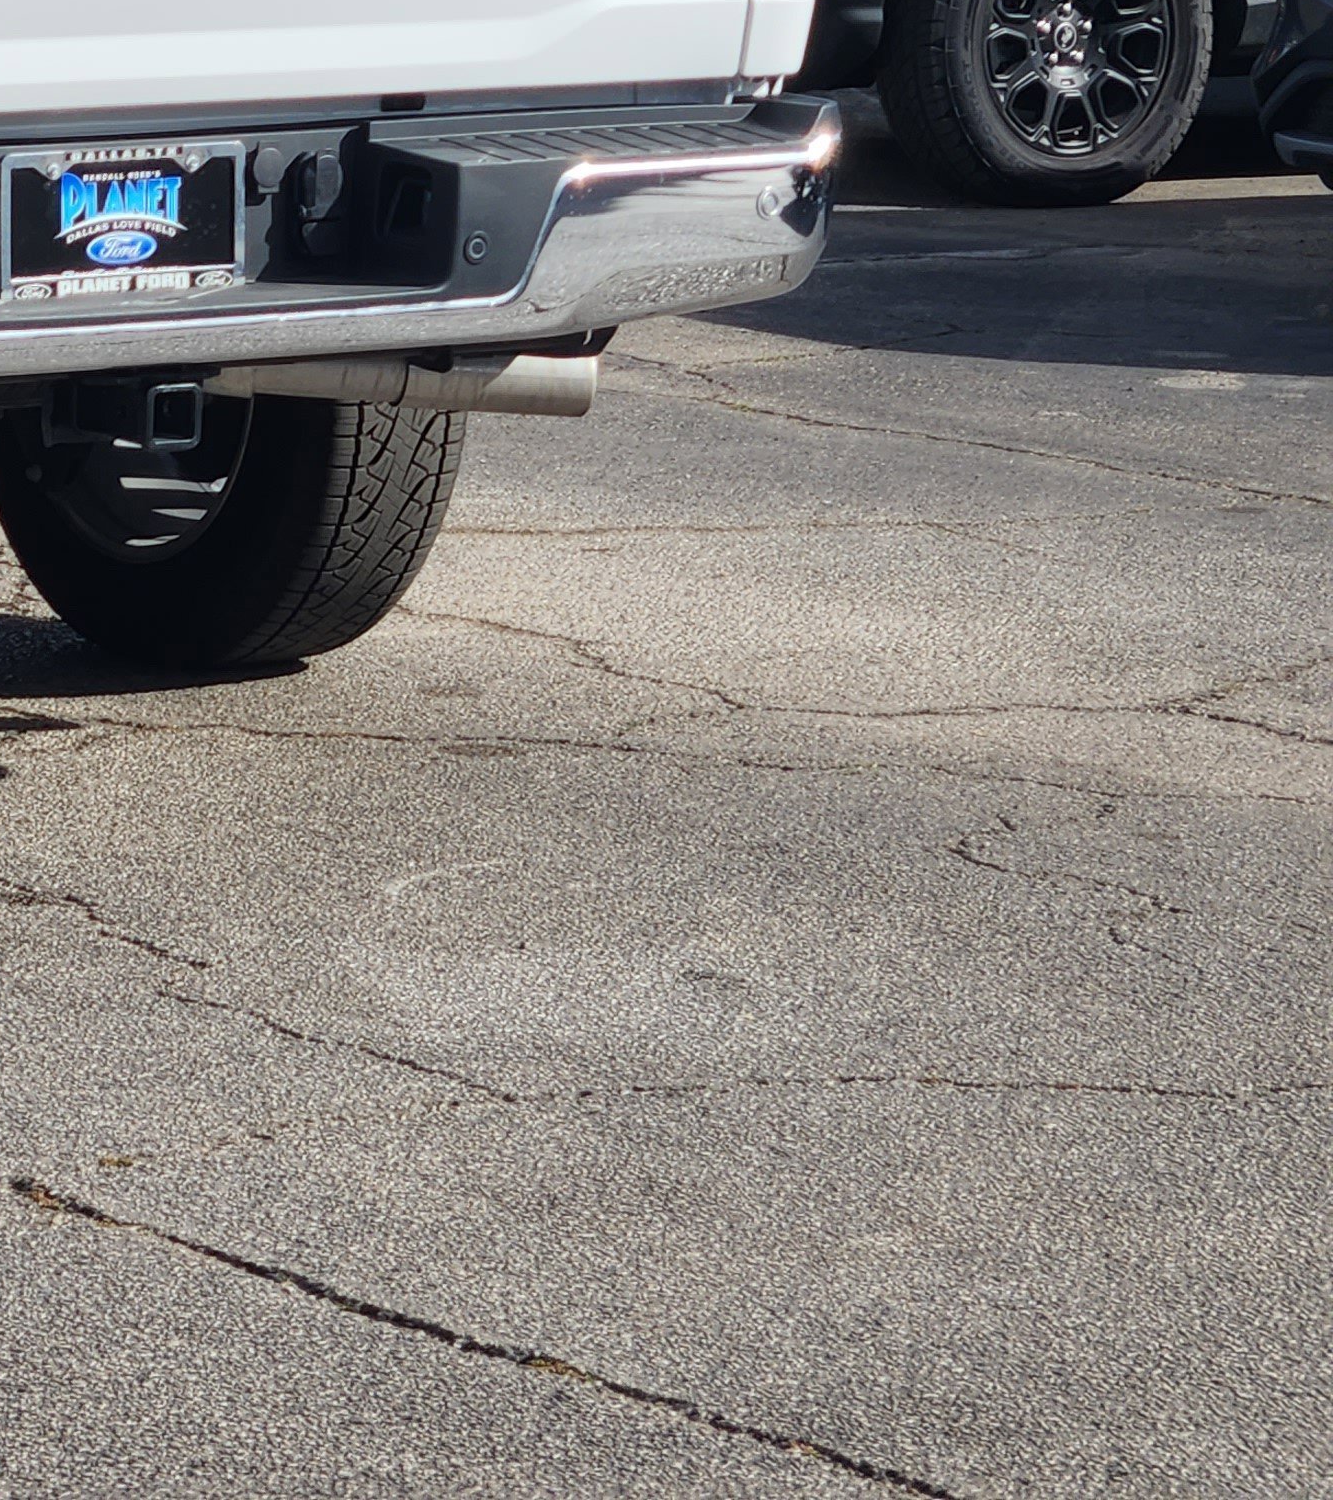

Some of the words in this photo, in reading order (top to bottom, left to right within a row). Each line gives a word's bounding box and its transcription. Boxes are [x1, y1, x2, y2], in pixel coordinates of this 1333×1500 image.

[60, 171, 183, 234] PLANET
[65, 222, 110, 245] DALLAS
[112, 219, 142, 232] LOVE
[144, 220, 177, 239] FIELD
[98, 238, 142, 258] Ford
[57, 274, 131, 298] PLANET
[136, 271, 191, 293] FORD
